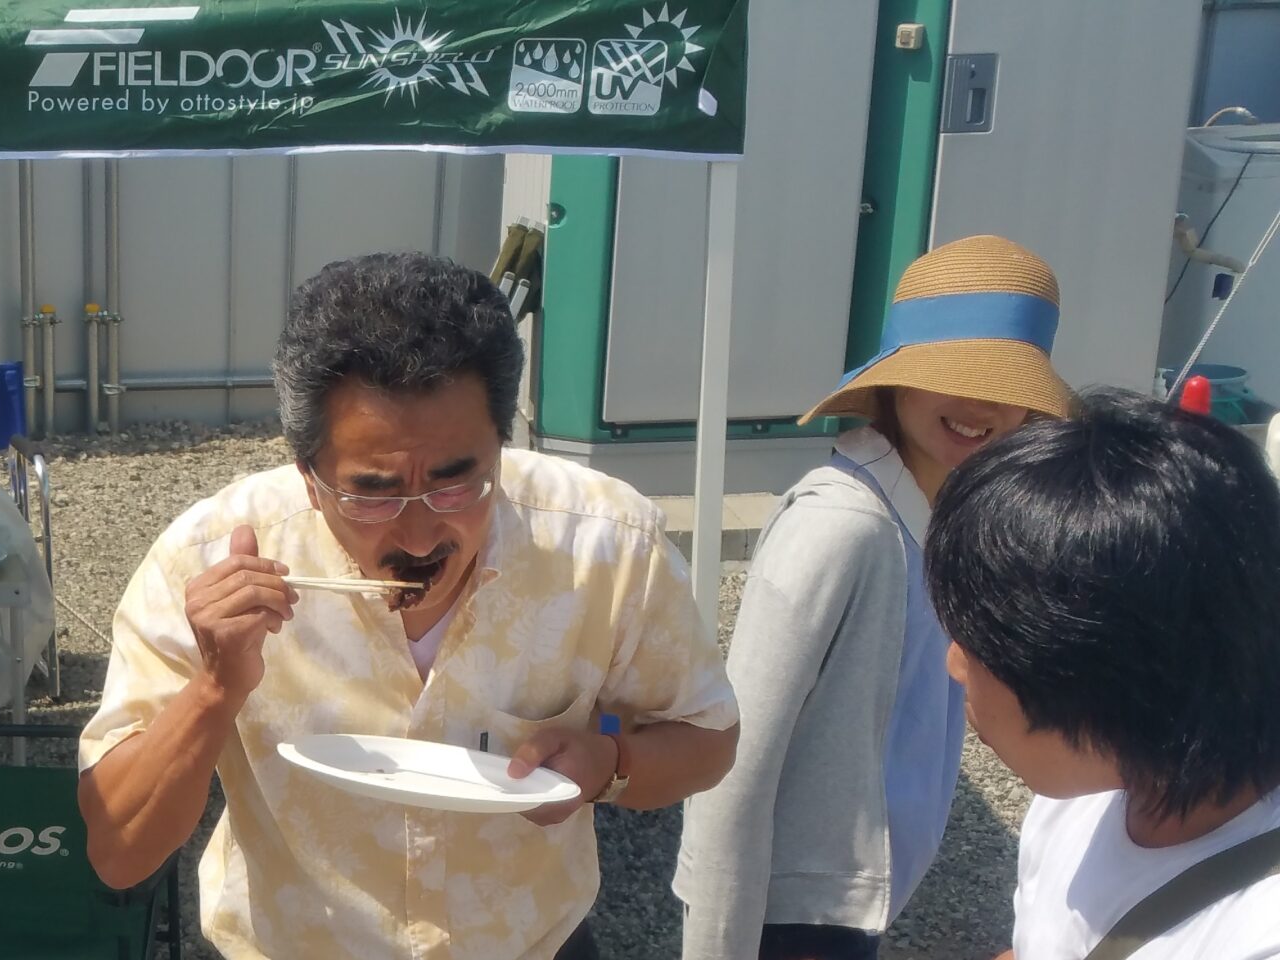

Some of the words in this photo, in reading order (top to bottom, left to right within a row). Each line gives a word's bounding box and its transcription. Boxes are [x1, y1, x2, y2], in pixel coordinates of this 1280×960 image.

[92, 48, 317, 88] FIELDOOR
[595, 72, 641, 100] UV
[27, 89, 130, 112] Powered
[141, 89, 169, 115] by
[180, 90, 315, 116] ottostyle.jp
[513, 99, 578, 110] WATERPROOF
[593, 101, 657, 112] PROTECTION
